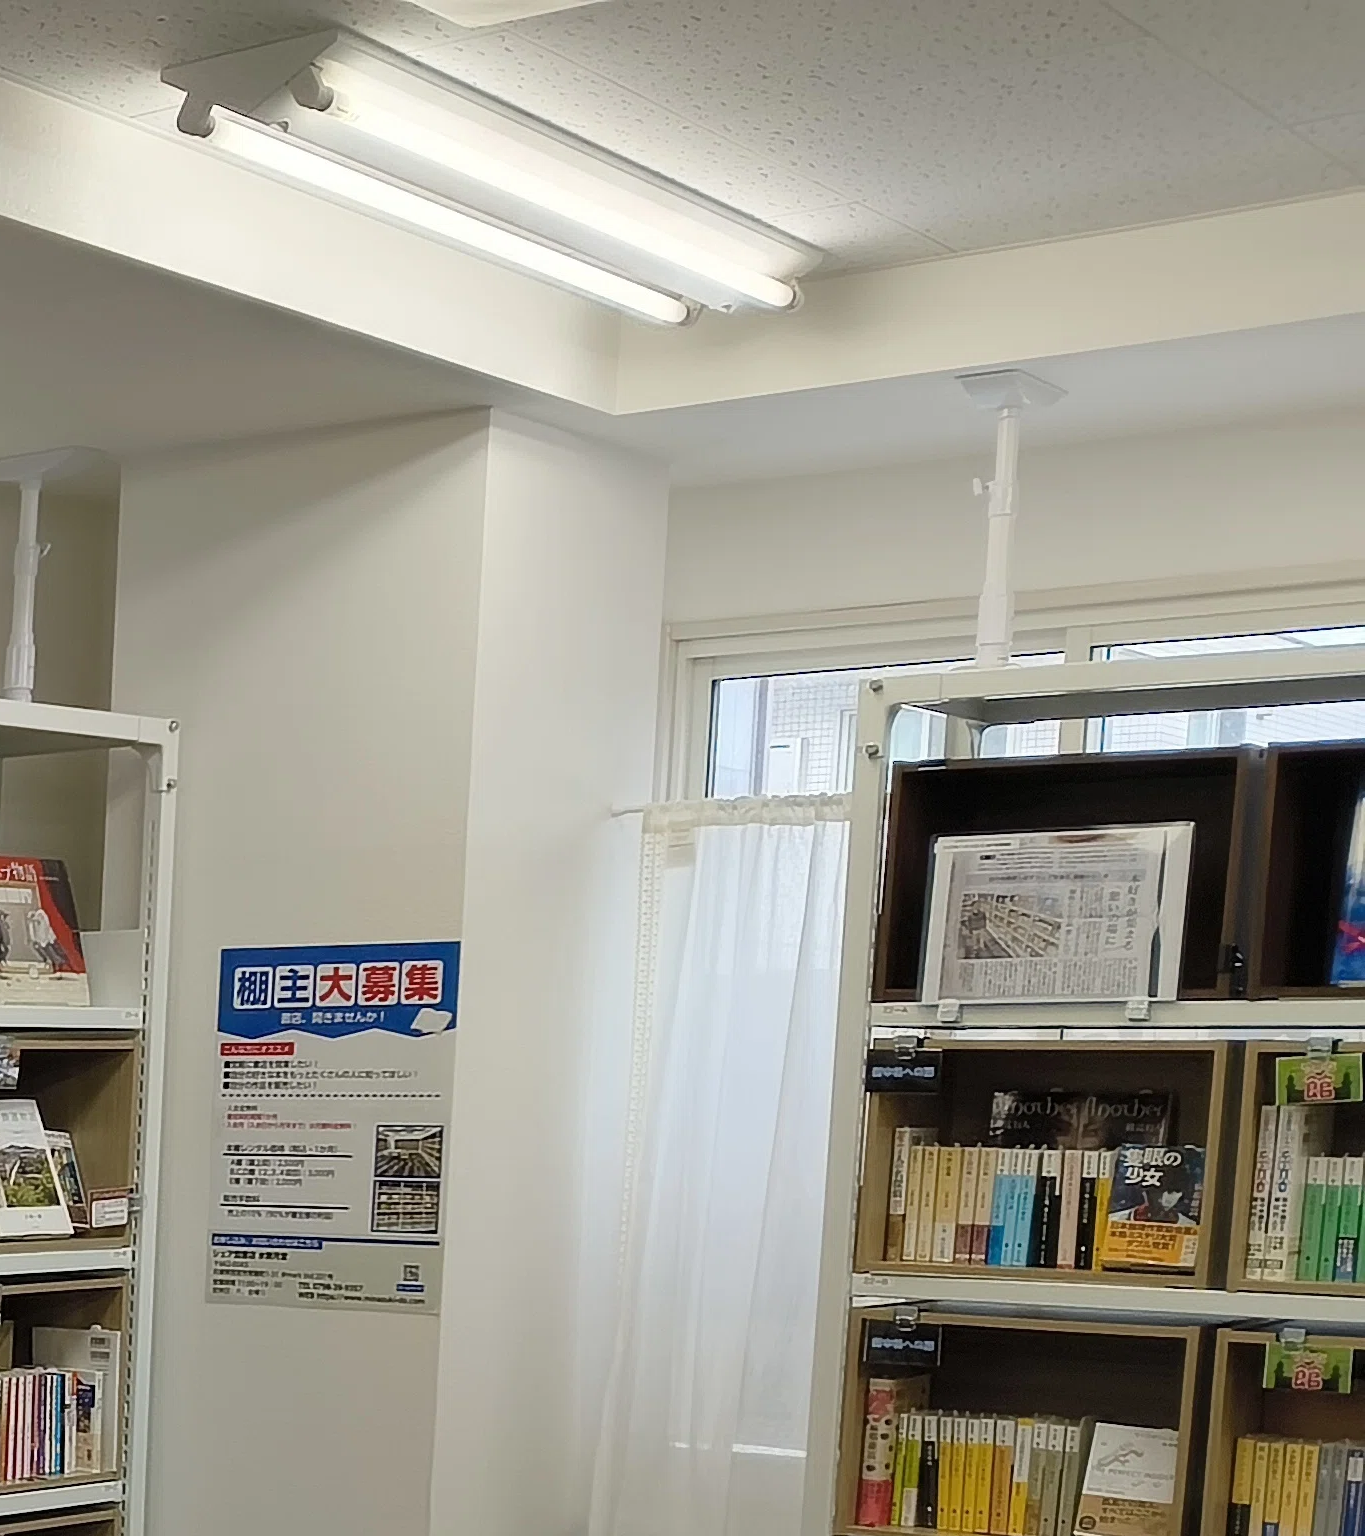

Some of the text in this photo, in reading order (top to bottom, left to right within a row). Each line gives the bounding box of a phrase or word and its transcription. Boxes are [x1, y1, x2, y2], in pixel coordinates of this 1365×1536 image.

[236, 963, 442, 1006] 棚主大募集
[1124, 1167, 1164, 1187] 少女
